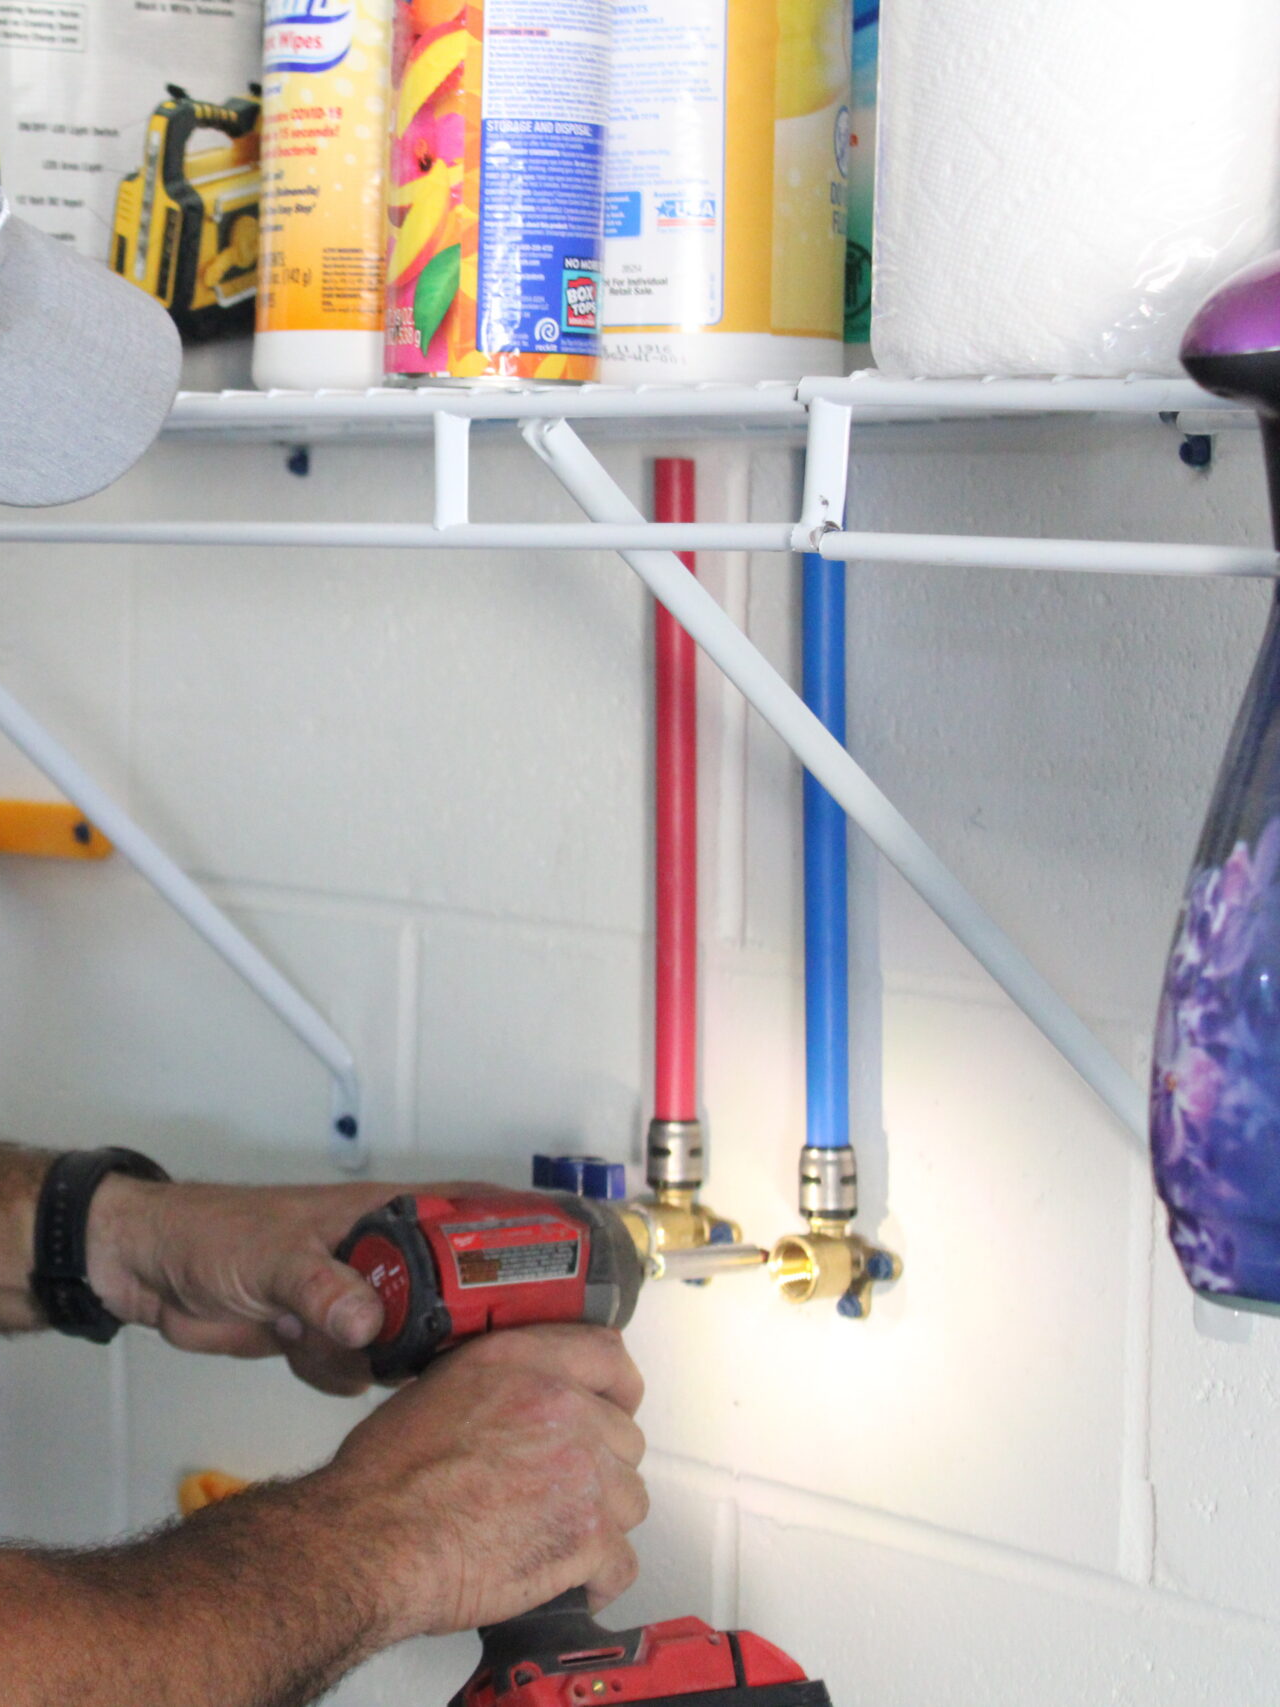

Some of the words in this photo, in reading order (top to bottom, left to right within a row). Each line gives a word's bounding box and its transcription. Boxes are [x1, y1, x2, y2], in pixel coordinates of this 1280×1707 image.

[279, 31, 323, 53] Wipes
[486, 119, 532, 132] STORAGE
[534, 121, 553, 132] AND
[555, 121, 592, 136] DISPOSAL:
[564, 257, 580, 269] NO
[627, 277, 668, 287] Individual
[567, 285, 594, 305] BOX
[571, 302, 597, 317] TOPS
